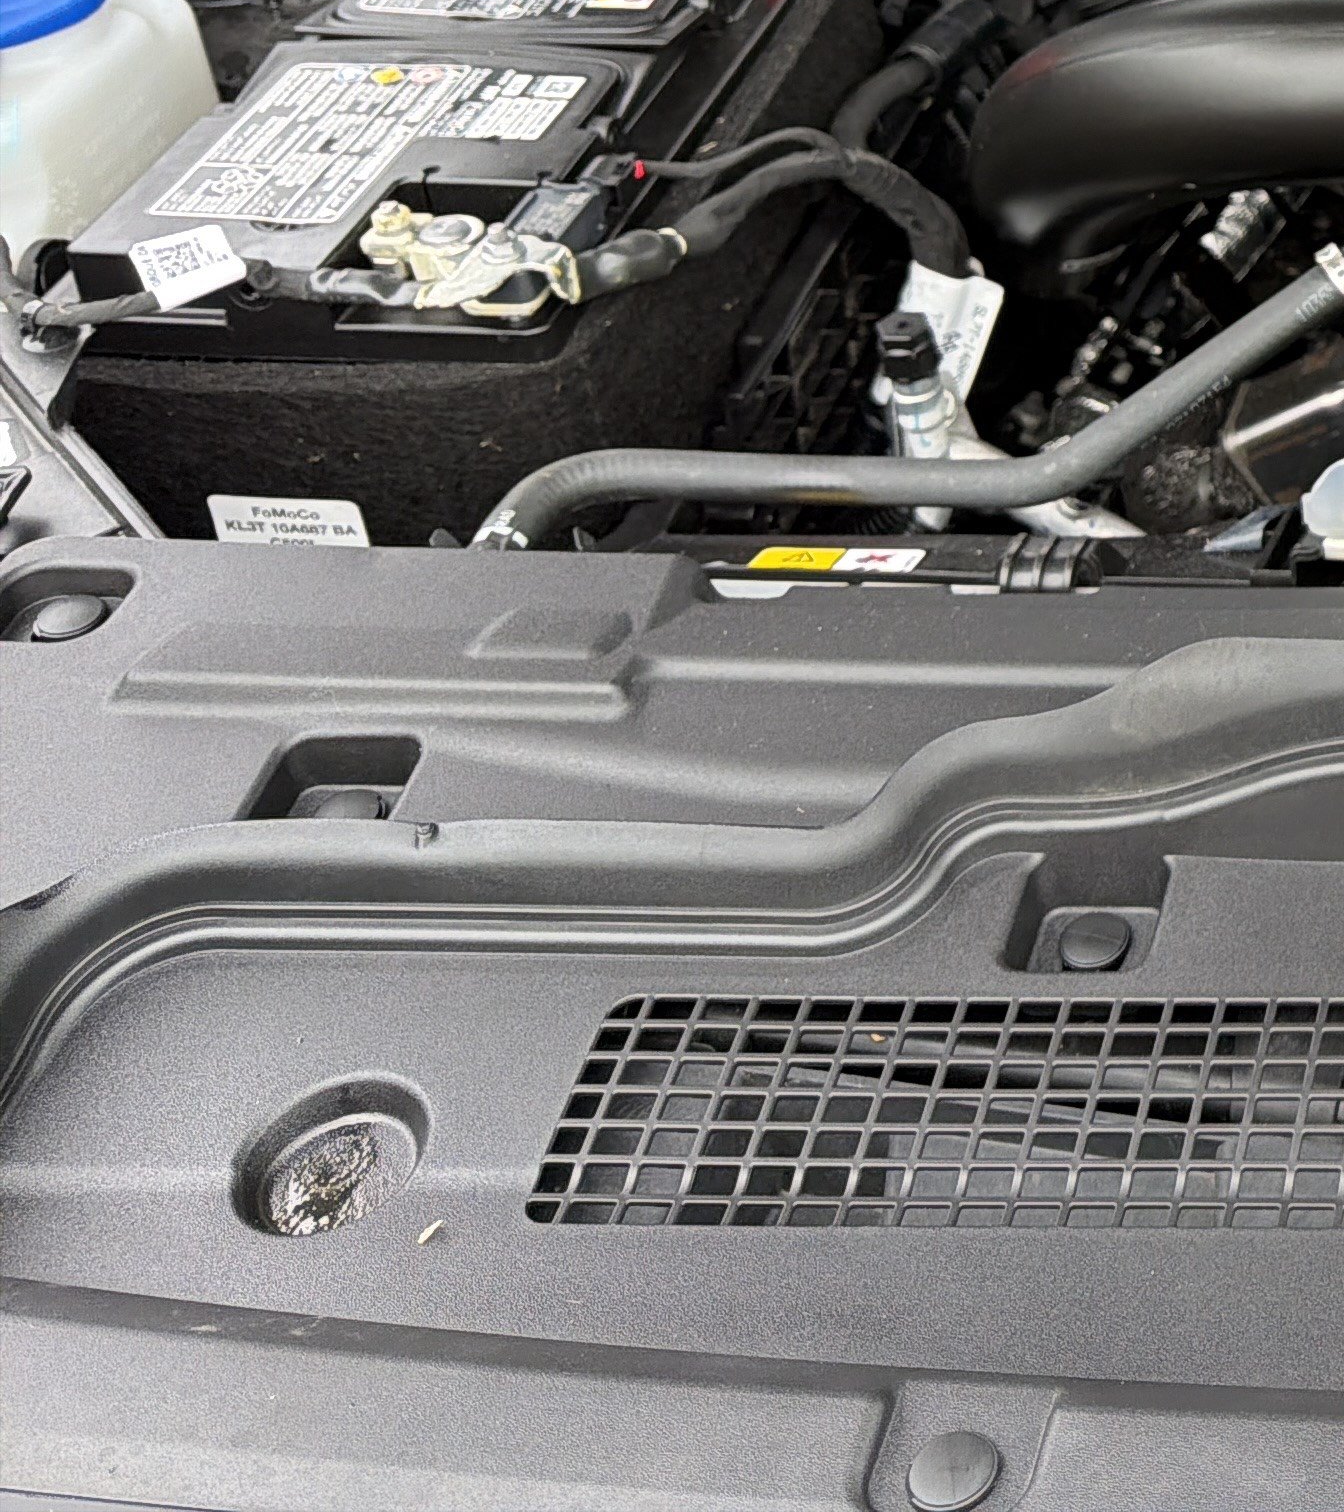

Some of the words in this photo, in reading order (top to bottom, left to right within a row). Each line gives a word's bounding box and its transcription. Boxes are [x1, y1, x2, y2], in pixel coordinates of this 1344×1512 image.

[251, 506, 321, 521] FoMoCo
[224, 519, 264, 534] KL3T
[332, 524, 358, 537] BA
